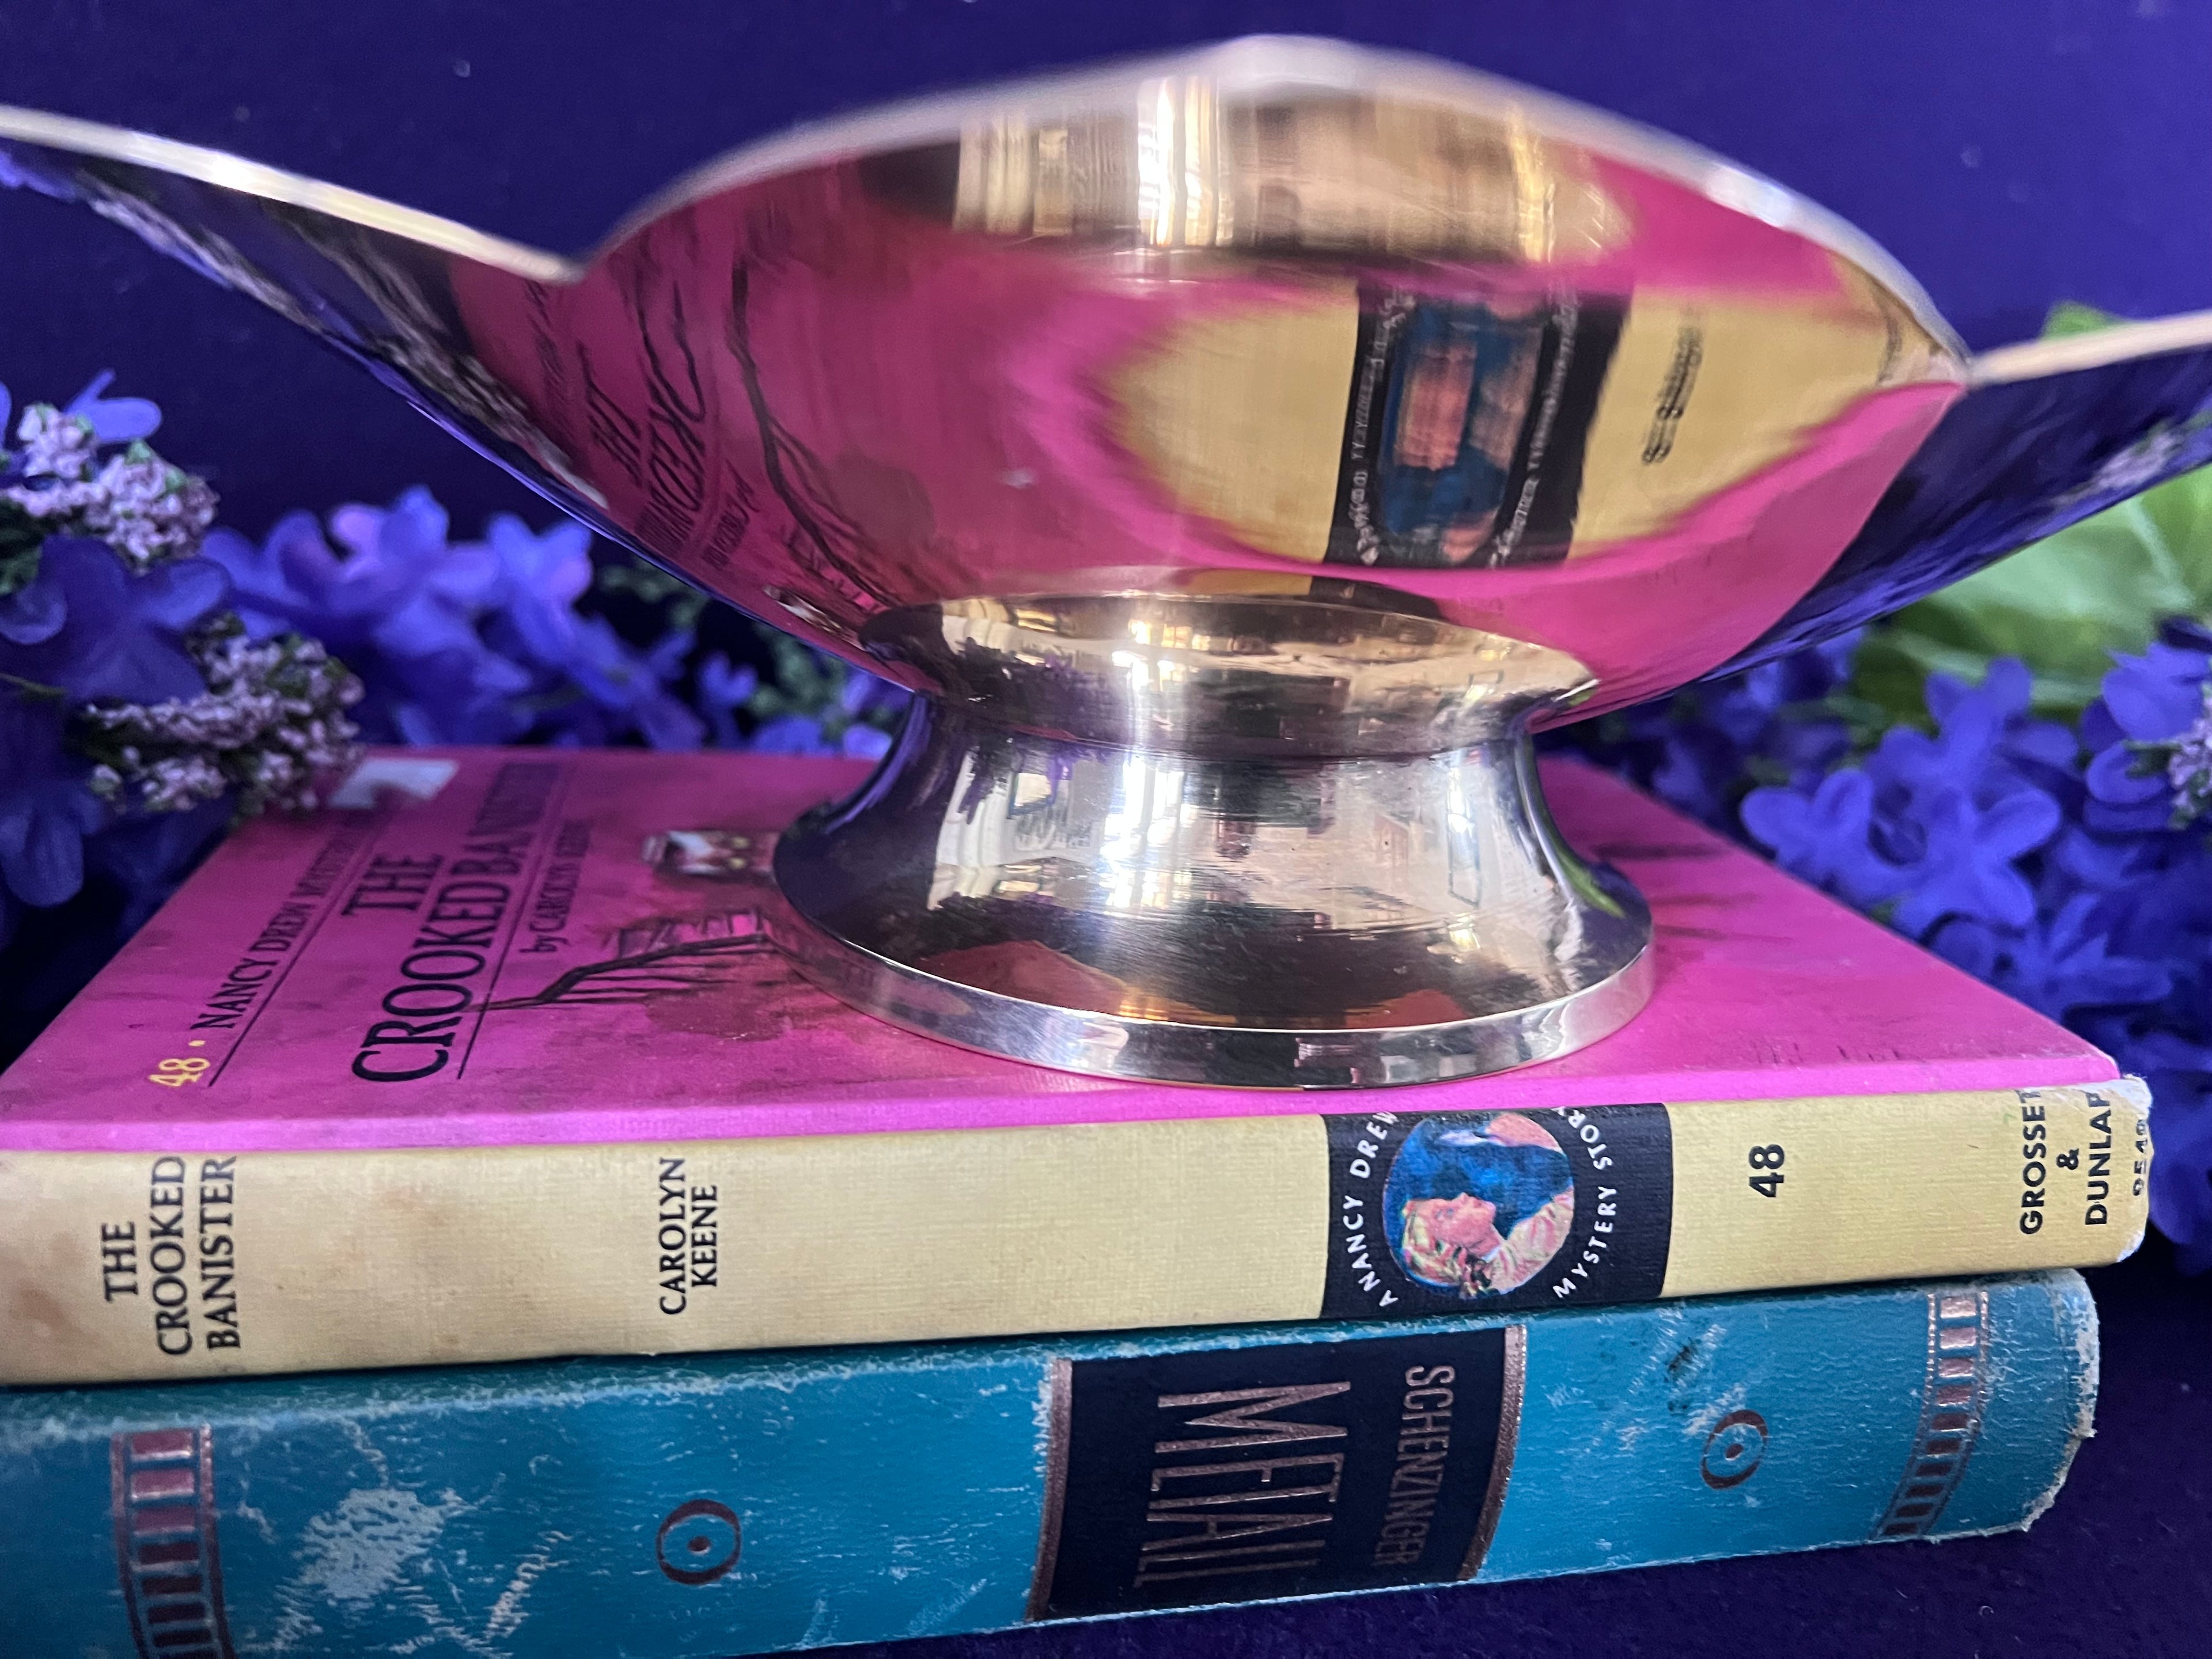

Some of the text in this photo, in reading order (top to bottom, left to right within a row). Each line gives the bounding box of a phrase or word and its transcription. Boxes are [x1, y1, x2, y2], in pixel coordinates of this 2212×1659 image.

[342, 853, 444, 916] THE
[518, 934, 570, 953] by
[148, 1057, 211, 1087] 48
[190, 957, 280, 1030] NANCY
[248, 901, 317, 952] DREW
[351, 881, 512, 1083] CROOKED
[1343, 1111, 1399, 1307] A NANCY DREW
[1748, 1143, 1785, 1198] 48
[2056, 1149, 2080, 1170] &
[2085, 1092, 2112, 1225] DUNLAP
[101, 1221, 138, 1302] THE
[150, 1156, 192, 1355] CROOKED
[199, 1155, 241, 1349] BANISTER
[658, 1157, 687, 1315] CAROLYN
[691, 1185, 717, 1287] KEENE
[1553, 1186, 1616, 1298] MYSTERY
[1133, 1380, 1351, 1588] METALL
[1372, 1365, 1456, 1566] SCHENZINGER
